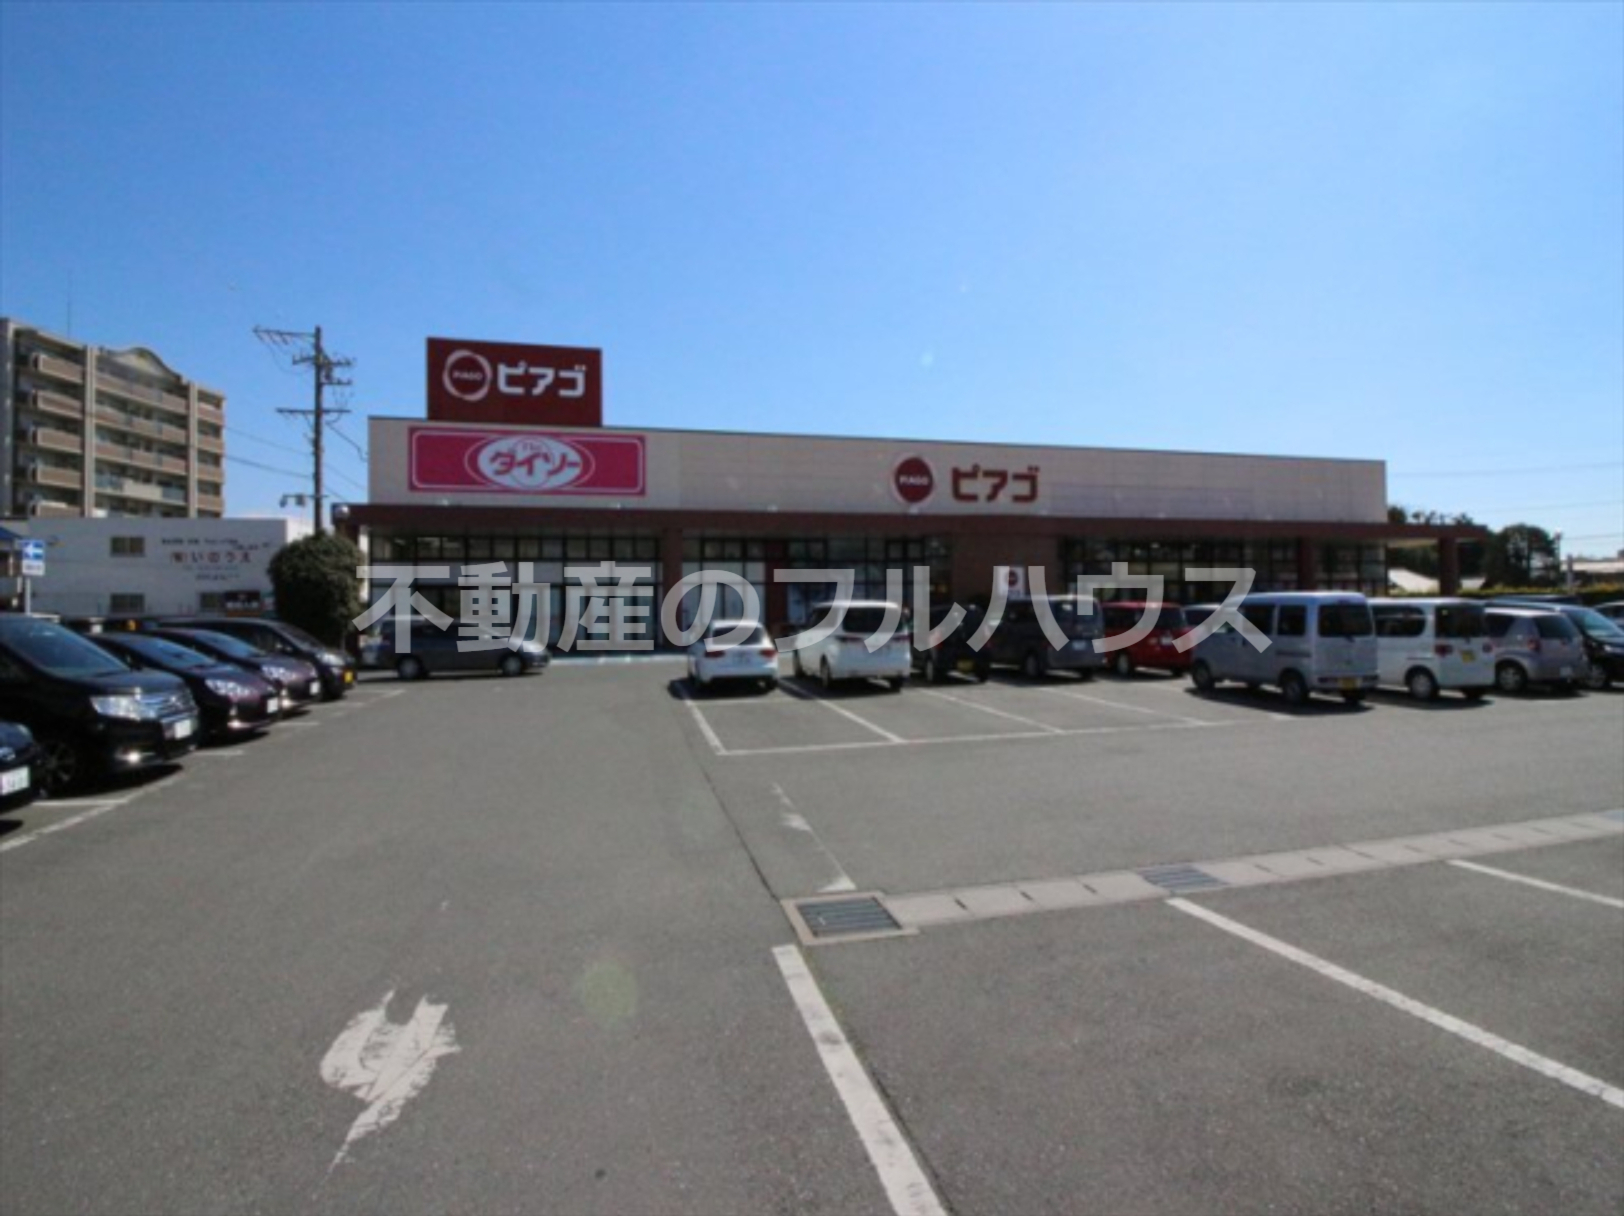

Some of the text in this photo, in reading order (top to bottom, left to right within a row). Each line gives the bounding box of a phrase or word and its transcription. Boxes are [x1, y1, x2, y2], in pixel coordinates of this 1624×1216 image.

[497, 361, 587, 398] ピアゴ
[489, 448, 580, 477] ダイソー
[952, 463, 1040, 502] ピアゴ
